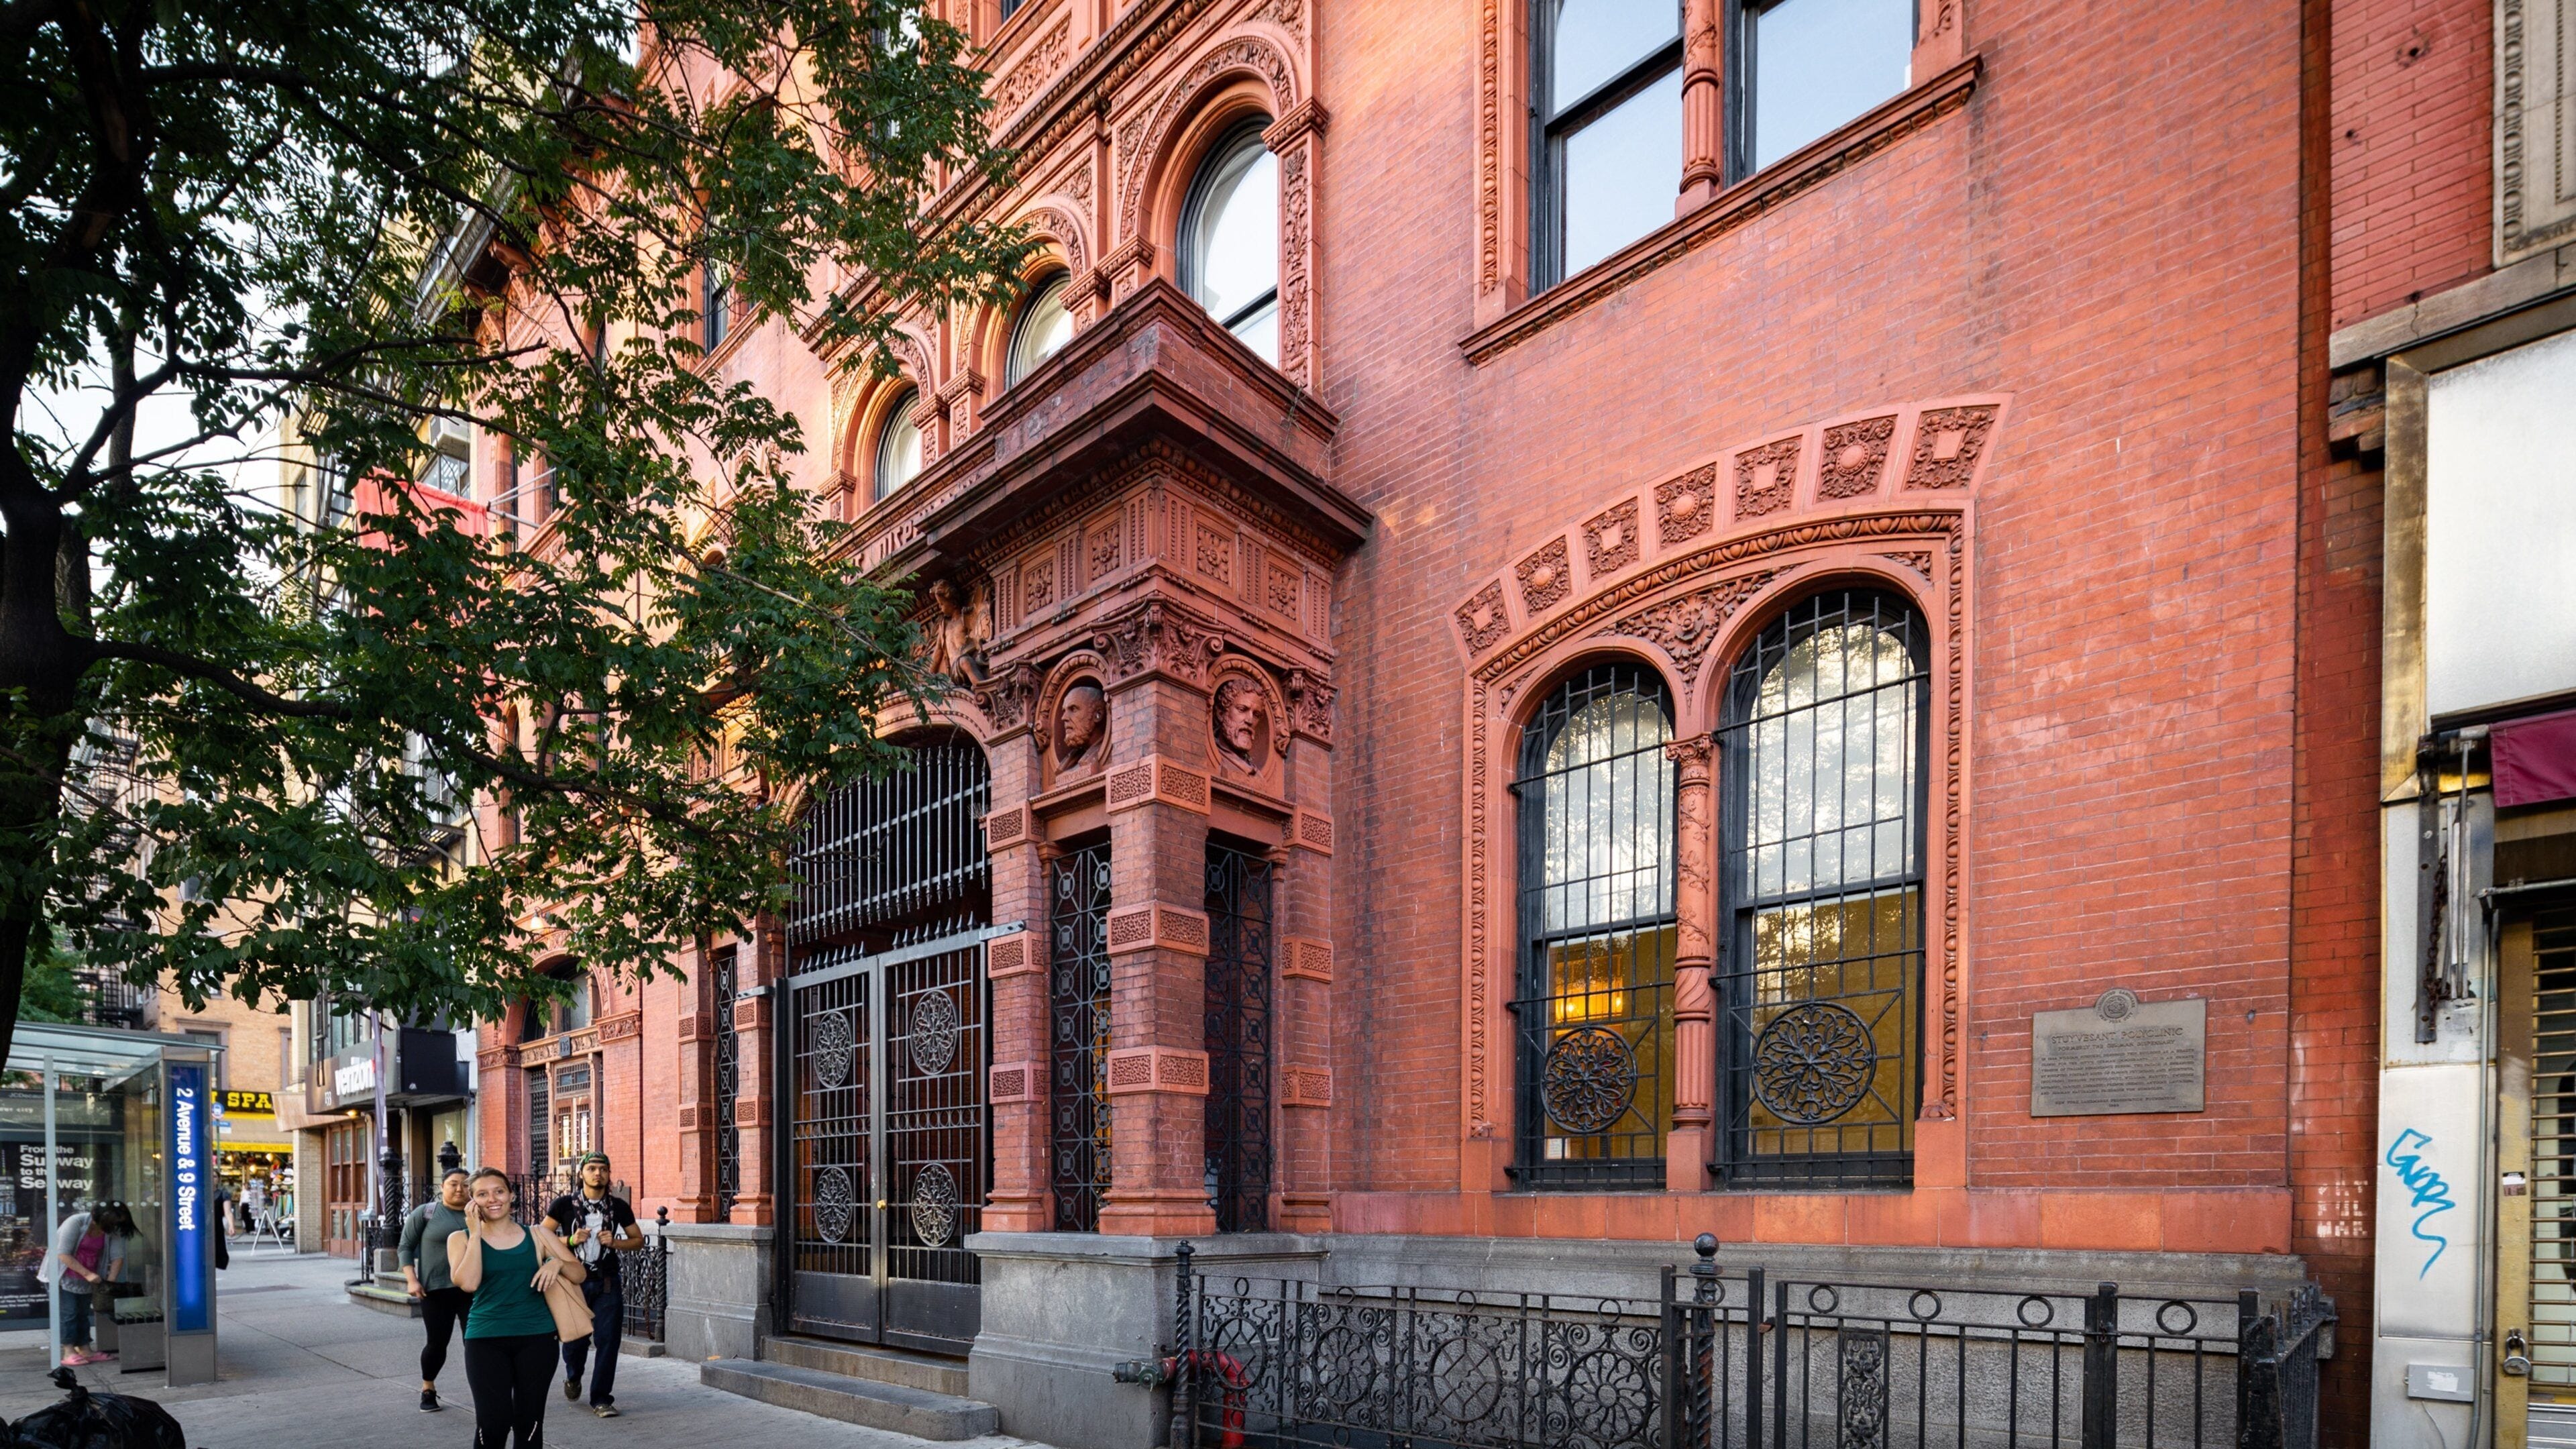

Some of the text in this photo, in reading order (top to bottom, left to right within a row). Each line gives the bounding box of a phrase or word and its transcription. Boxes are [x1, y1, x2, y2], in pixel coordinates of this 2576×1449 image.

[2051, 1027, 2184, 1044] STUYVESANT POLYCLINIC
[2057, 1044, 2090, 1052] FORMERLY
[335, 1059, 376, 1096] verizon
[227, 1091, 272, 1109] SPA
[56, 1145, 74, 1154] the
[19, 1153, 94, 1169] Suway
[176, 1087, 197, 1231] 2 Avenue & 9 Street
[19, 1167, 48, 1176] to th
[20, 1176, 93, 1191] Seway
